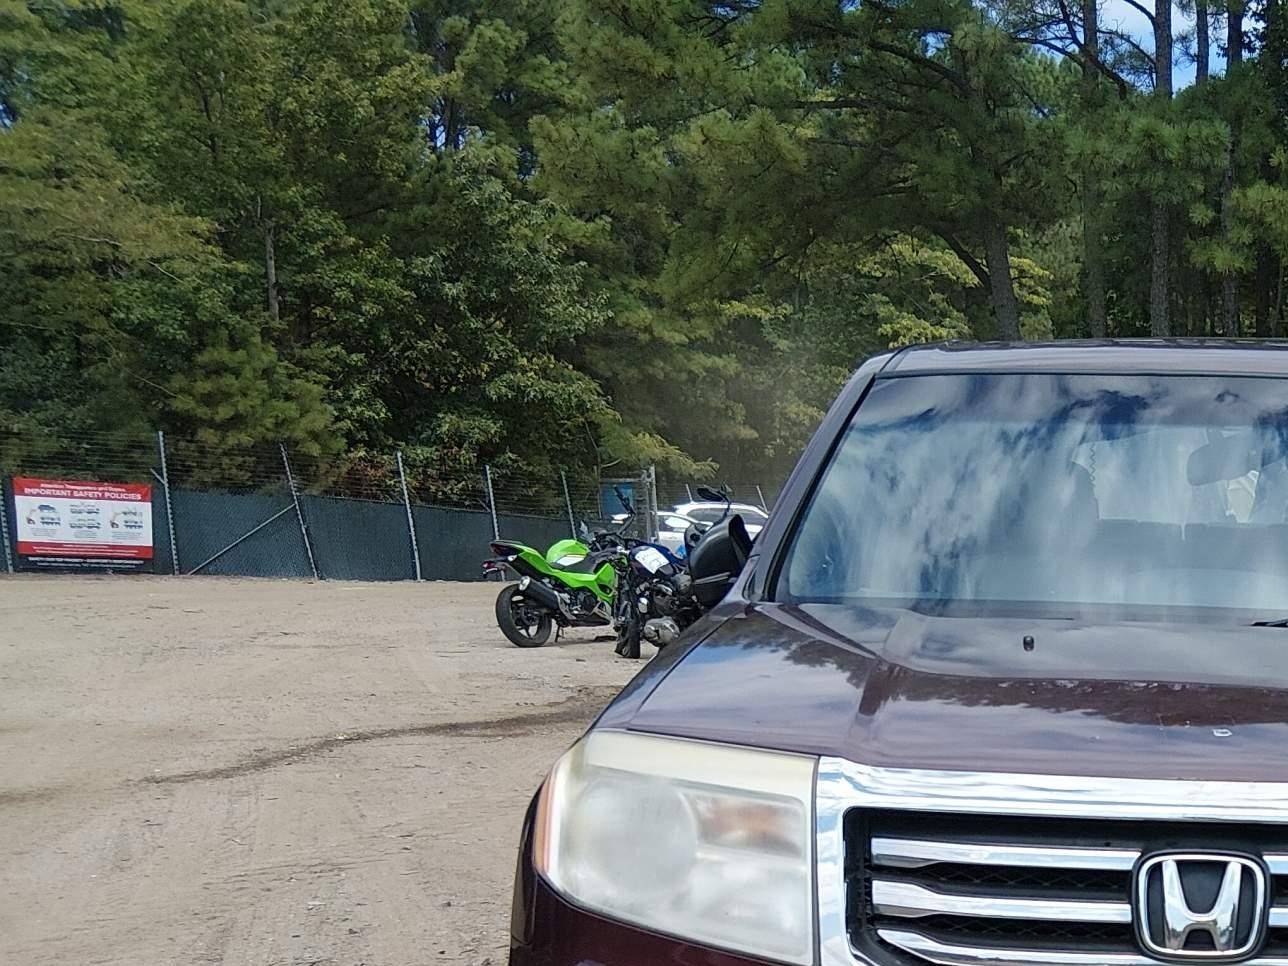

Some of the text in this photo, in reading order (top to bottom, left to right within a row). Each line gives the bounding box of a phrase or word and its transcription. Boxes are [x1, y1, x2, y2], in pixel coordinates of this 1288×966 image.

[24, 487, 72, 497] IMPORTANT
[73, 490, 103, 499] SAFETY
[104, 492, 142, 501] POLICIES
